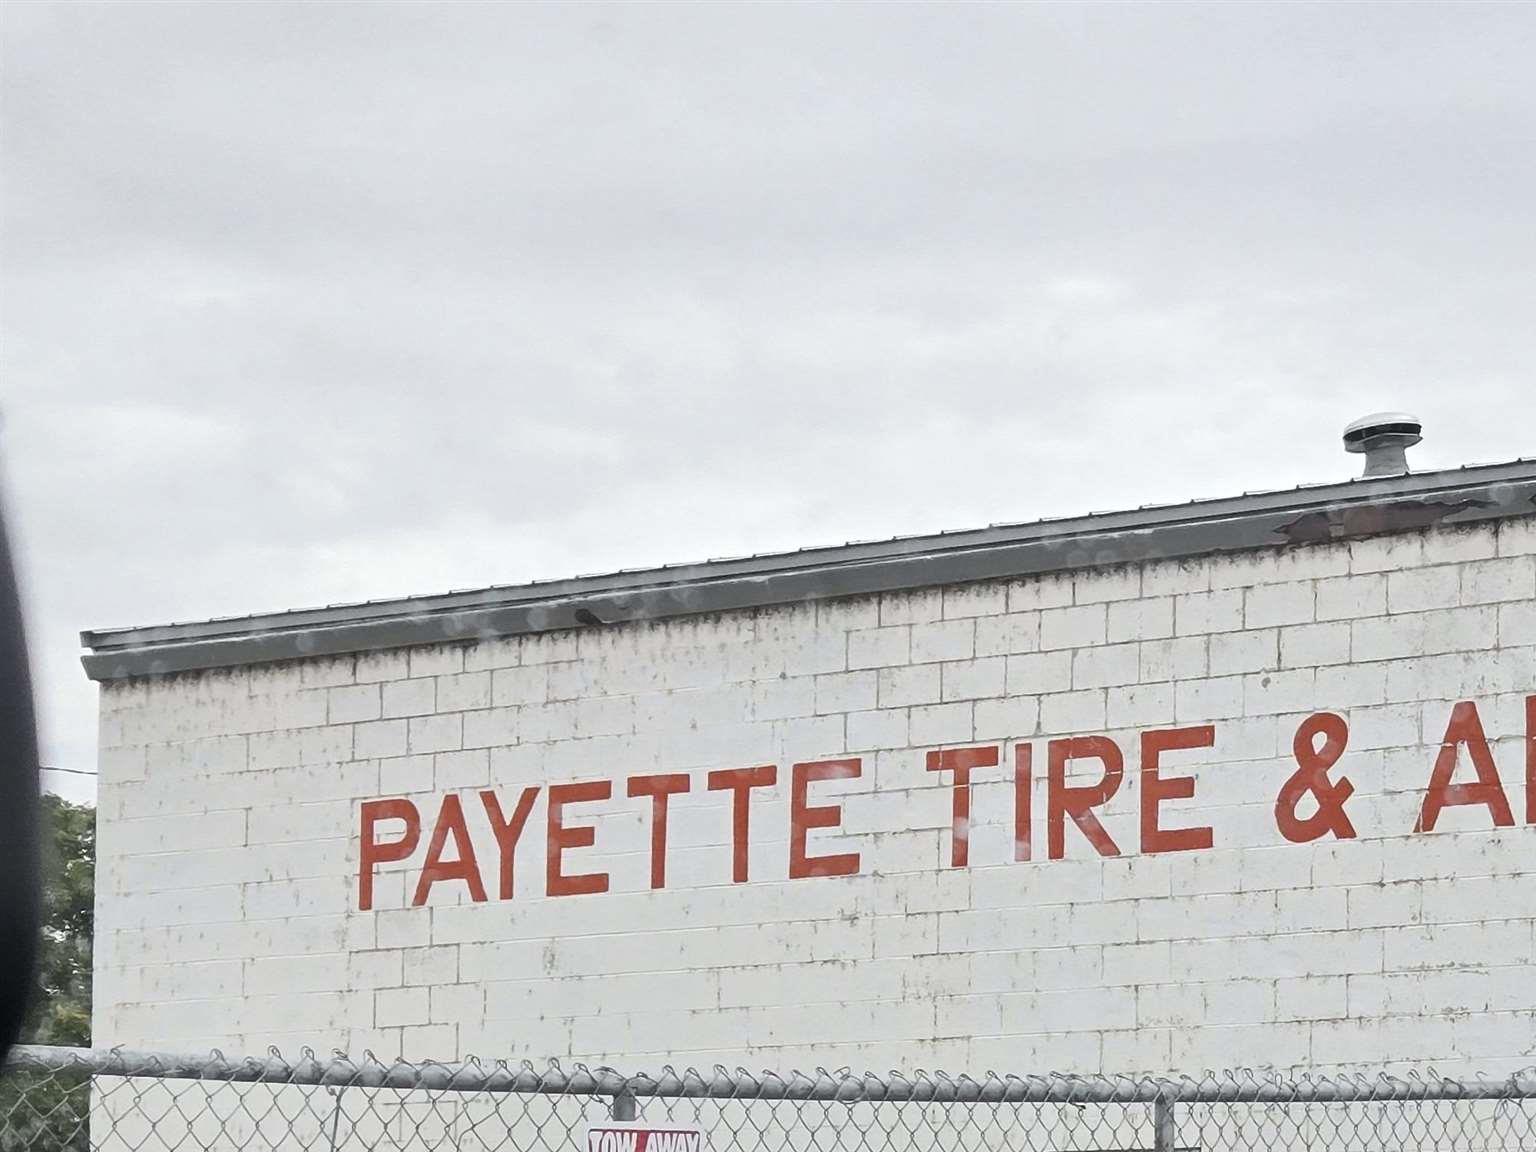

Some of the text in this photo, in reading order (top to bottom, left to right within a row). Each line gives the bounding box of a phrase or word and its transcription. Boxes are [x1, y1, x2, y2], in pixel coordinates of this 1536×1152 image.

[358, 757, 862, 911] PAYETTE
[925, 724, 1215, 868] TIRE
[1274, 711, 1356, 844] &
